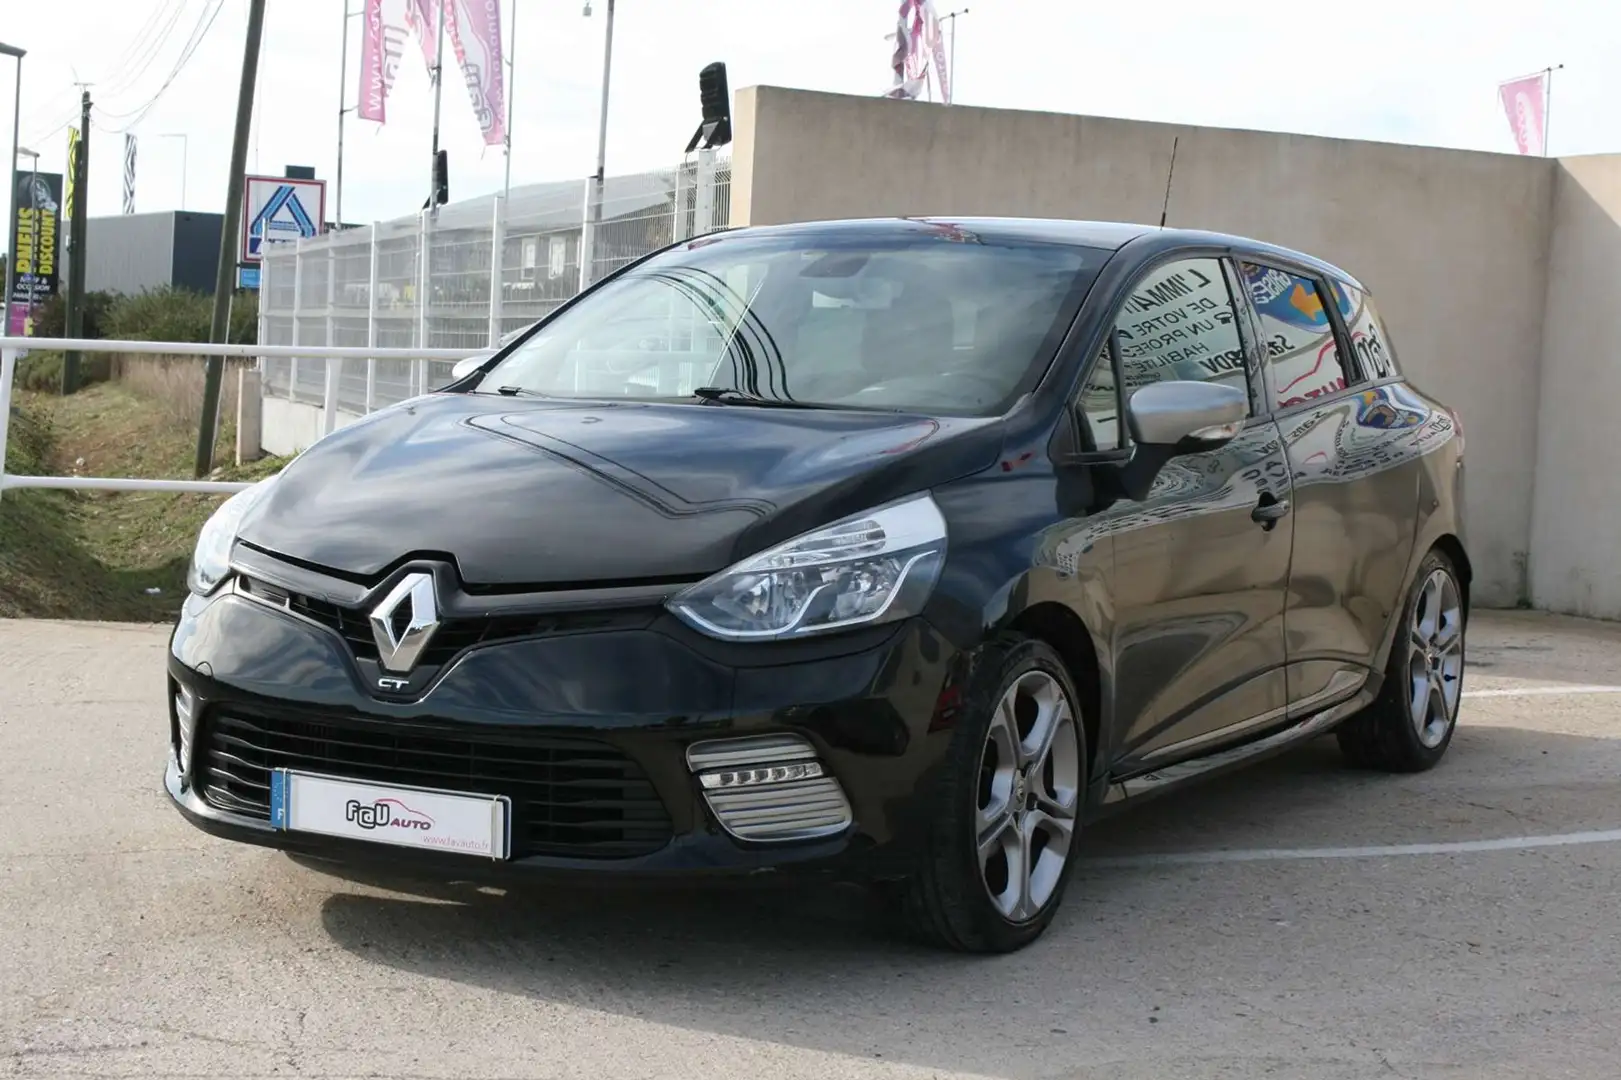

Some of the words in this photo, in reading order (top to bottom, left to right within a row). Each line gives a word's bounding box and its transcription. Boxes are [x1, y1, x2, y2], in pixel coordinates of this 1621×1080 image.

[39, 209, 56, 275] DISCOUNT
[16, 283, 50, 291] OCCSION
[277, 808, 284, 820] F
[390, 817, 431, 830] AUTO
[423, 835, 488, 850] www.favauto.fr
